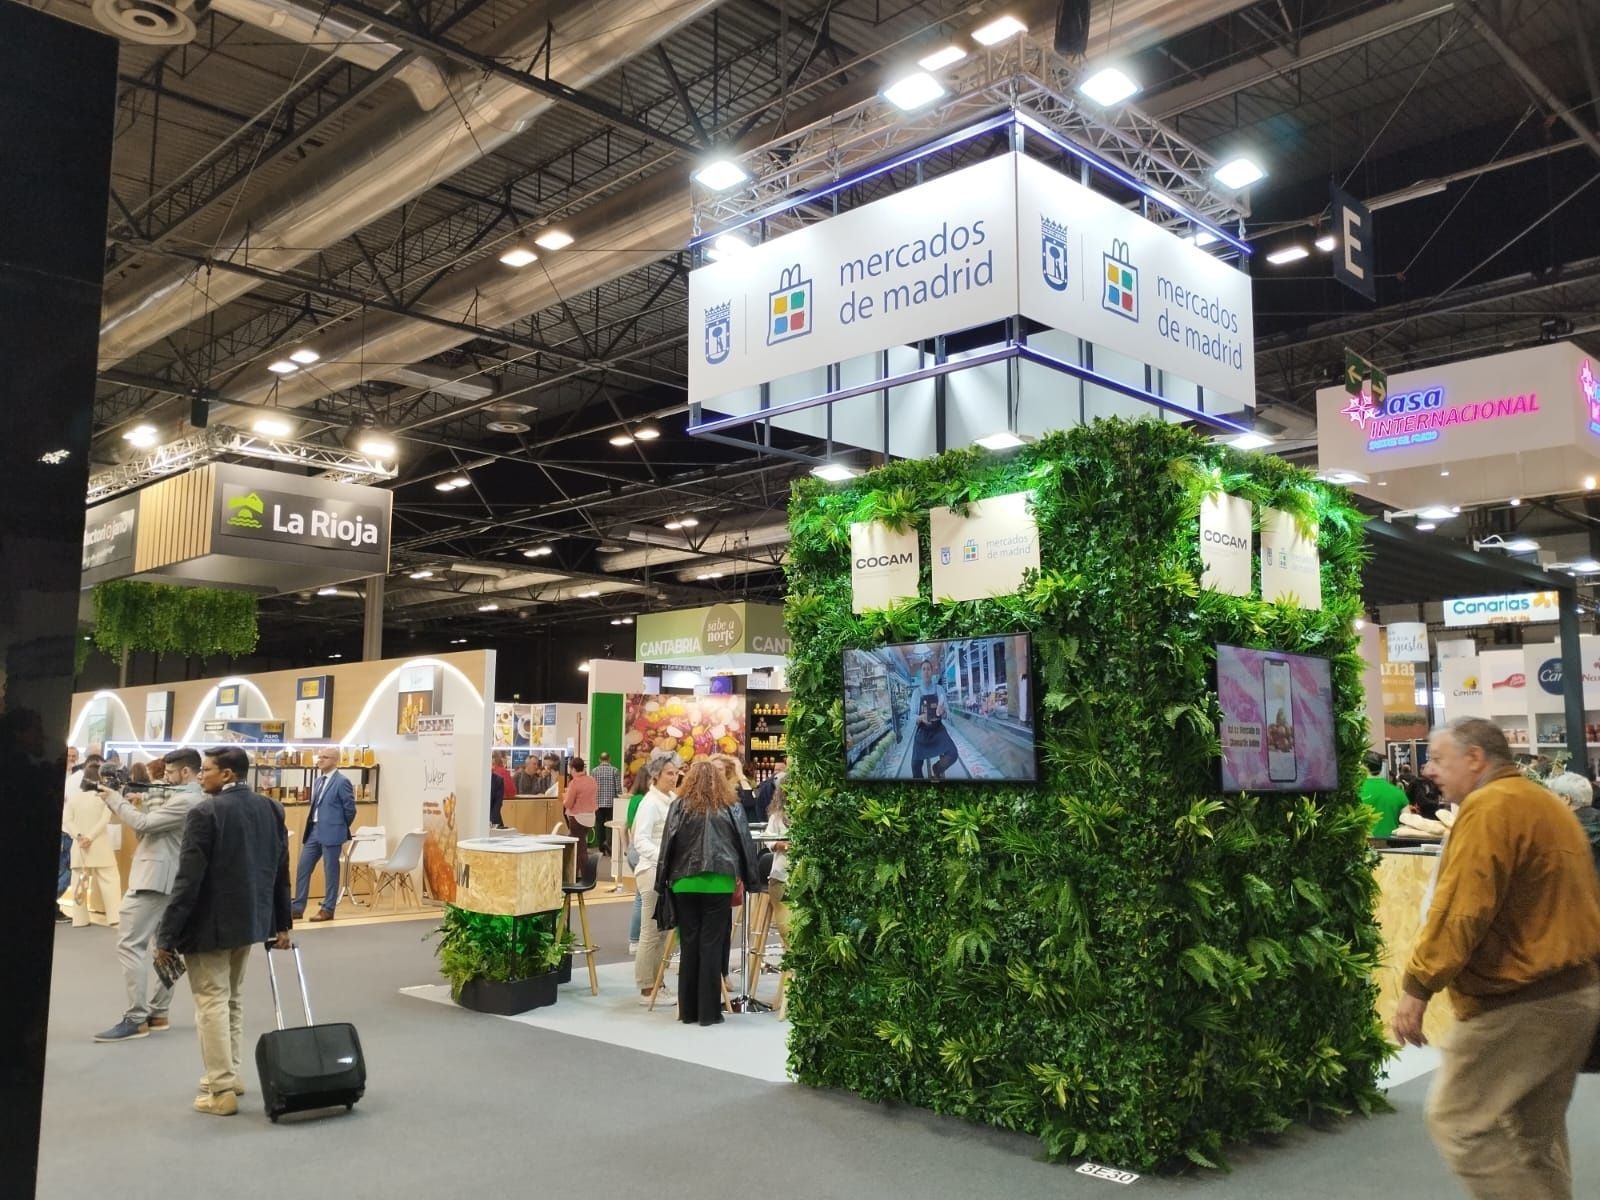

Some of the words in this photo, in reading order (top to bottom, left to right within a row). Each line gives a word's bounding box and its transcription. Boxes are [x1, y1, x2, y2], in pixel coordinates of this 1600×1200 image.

[840, 220, 986, 287] mercados
[1342, 206, 1364, 280] E
[839, 290, 874, 325] de
[884, 250, 993, 313] madrid
[1157, 275, 1238, 333] mercados
[1158, 307, 1180, 342] de
[1186, 325, 1242, 370] madrid
[1370, 394, 1540, 438] INTERNACIONAL
[273, 504, 304, 535] La
[311, 509, 378, 547] Rioja
[986, 534, 1028, 548] mercados
[1203, 529, 1248, 550] COCAM
[855, 552, 913, 570] COCAM
[987, 547, 998, 559] de
[1000, 544, 1031, 558] madrid
[1453, 598, 1530, 615] Canarias
[707, 617, 726, 632] sabe
[640, 637, 701, 657] CANTABRIA
[707, 630, 735, 646] norte
[1394, 635, 1424, 657] gusta
[1081, 1164, 1135, 1182] 3E30
